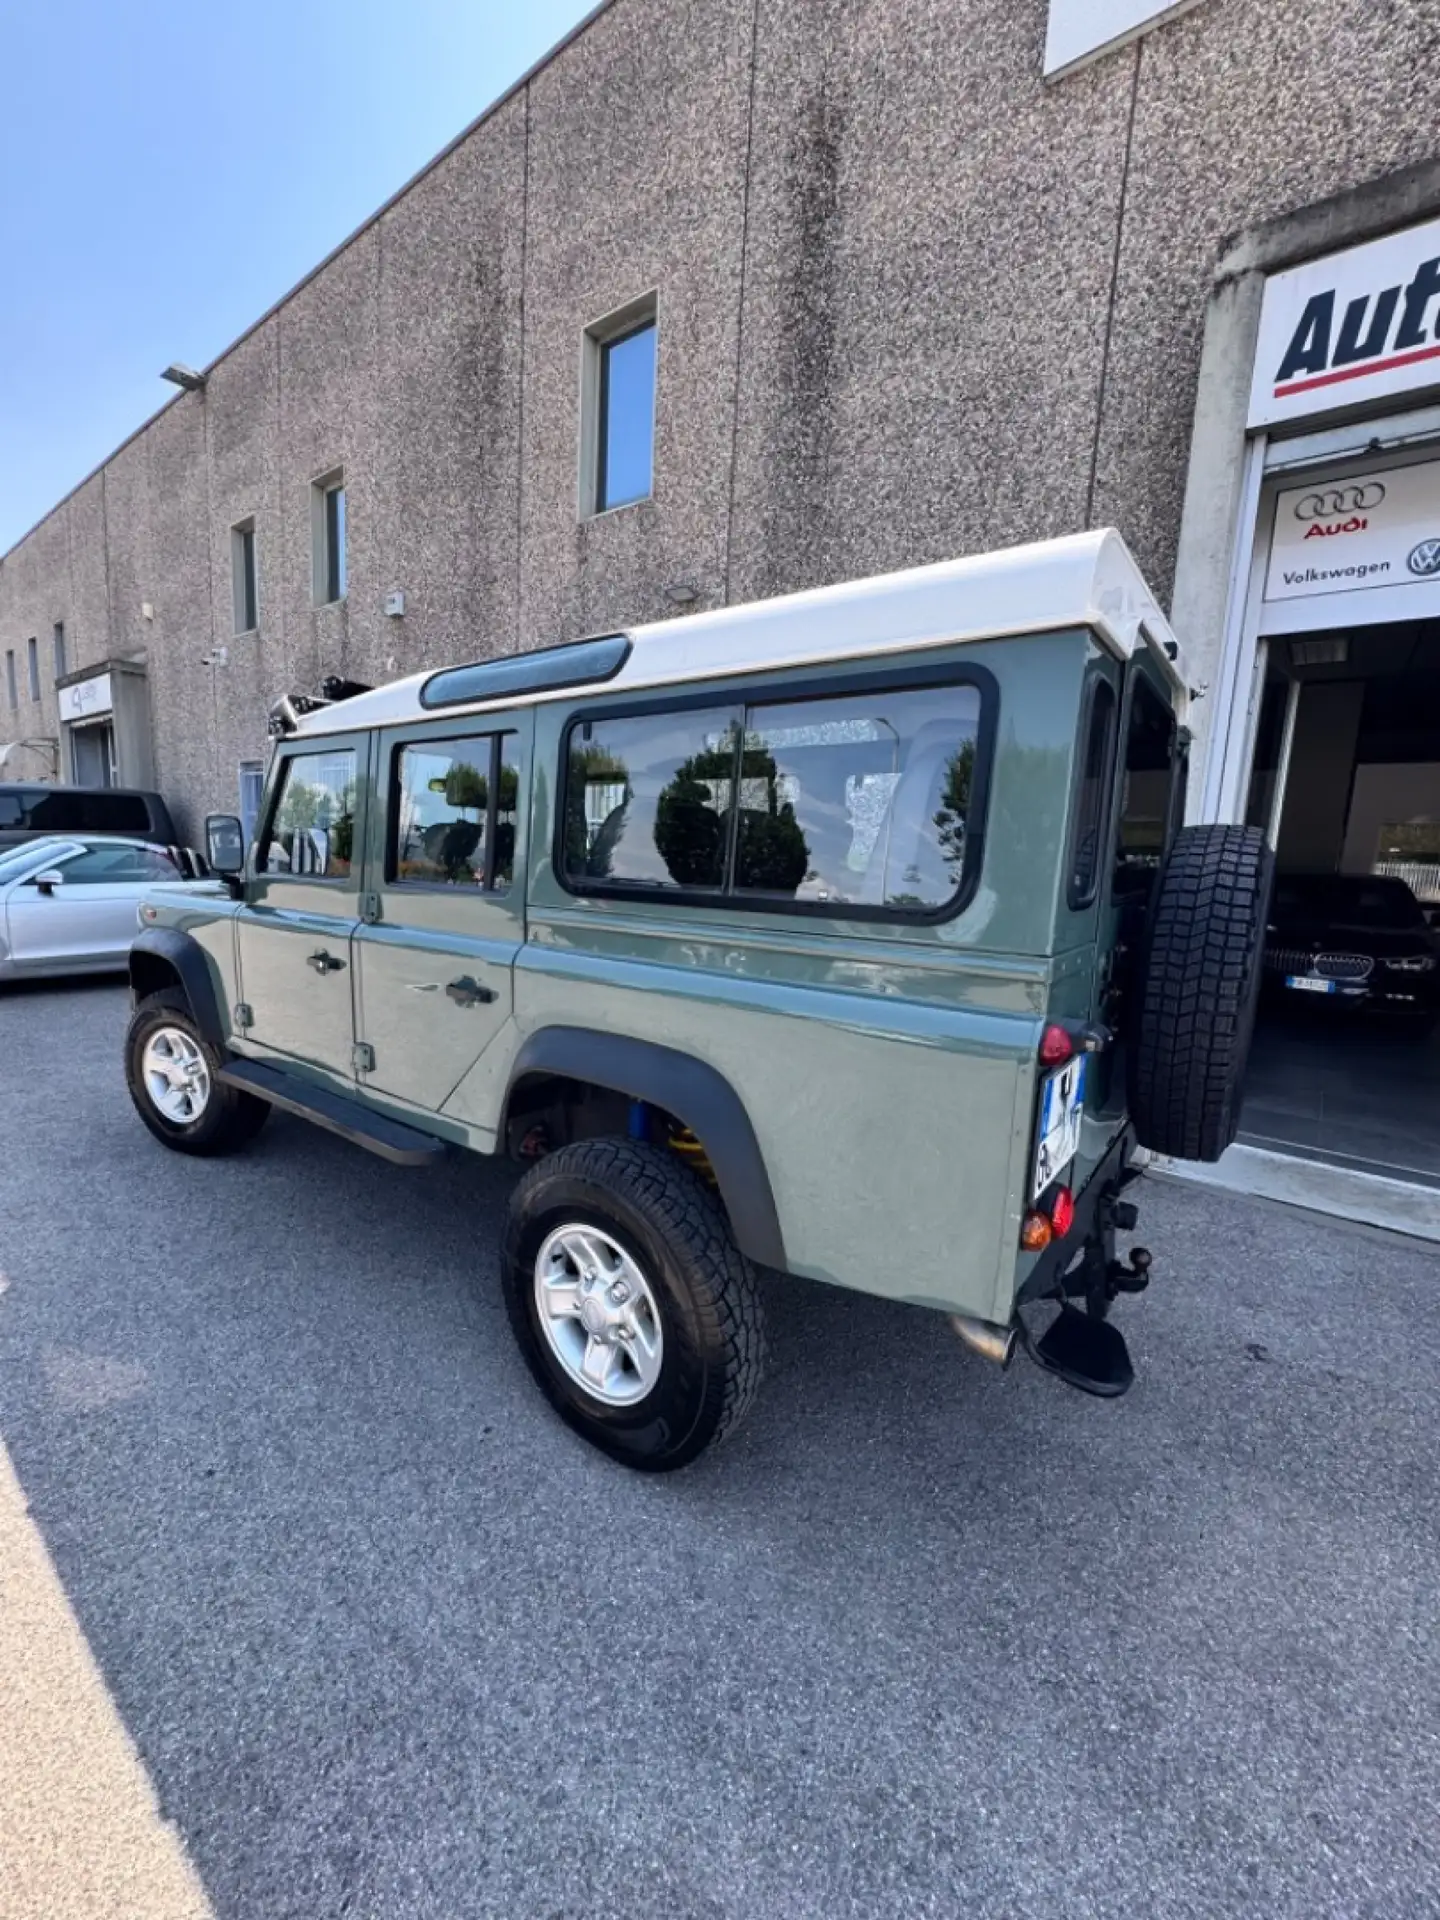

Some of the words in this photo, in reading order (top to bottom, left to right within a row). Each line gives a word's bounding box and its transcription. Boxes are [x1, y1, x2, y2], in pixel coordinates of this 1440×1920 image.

[1274, 256, 1440, 382] Aut
[1303, 516, 1368, 539] Audi
[1283, 561, 1390, 584] Volkswagen
